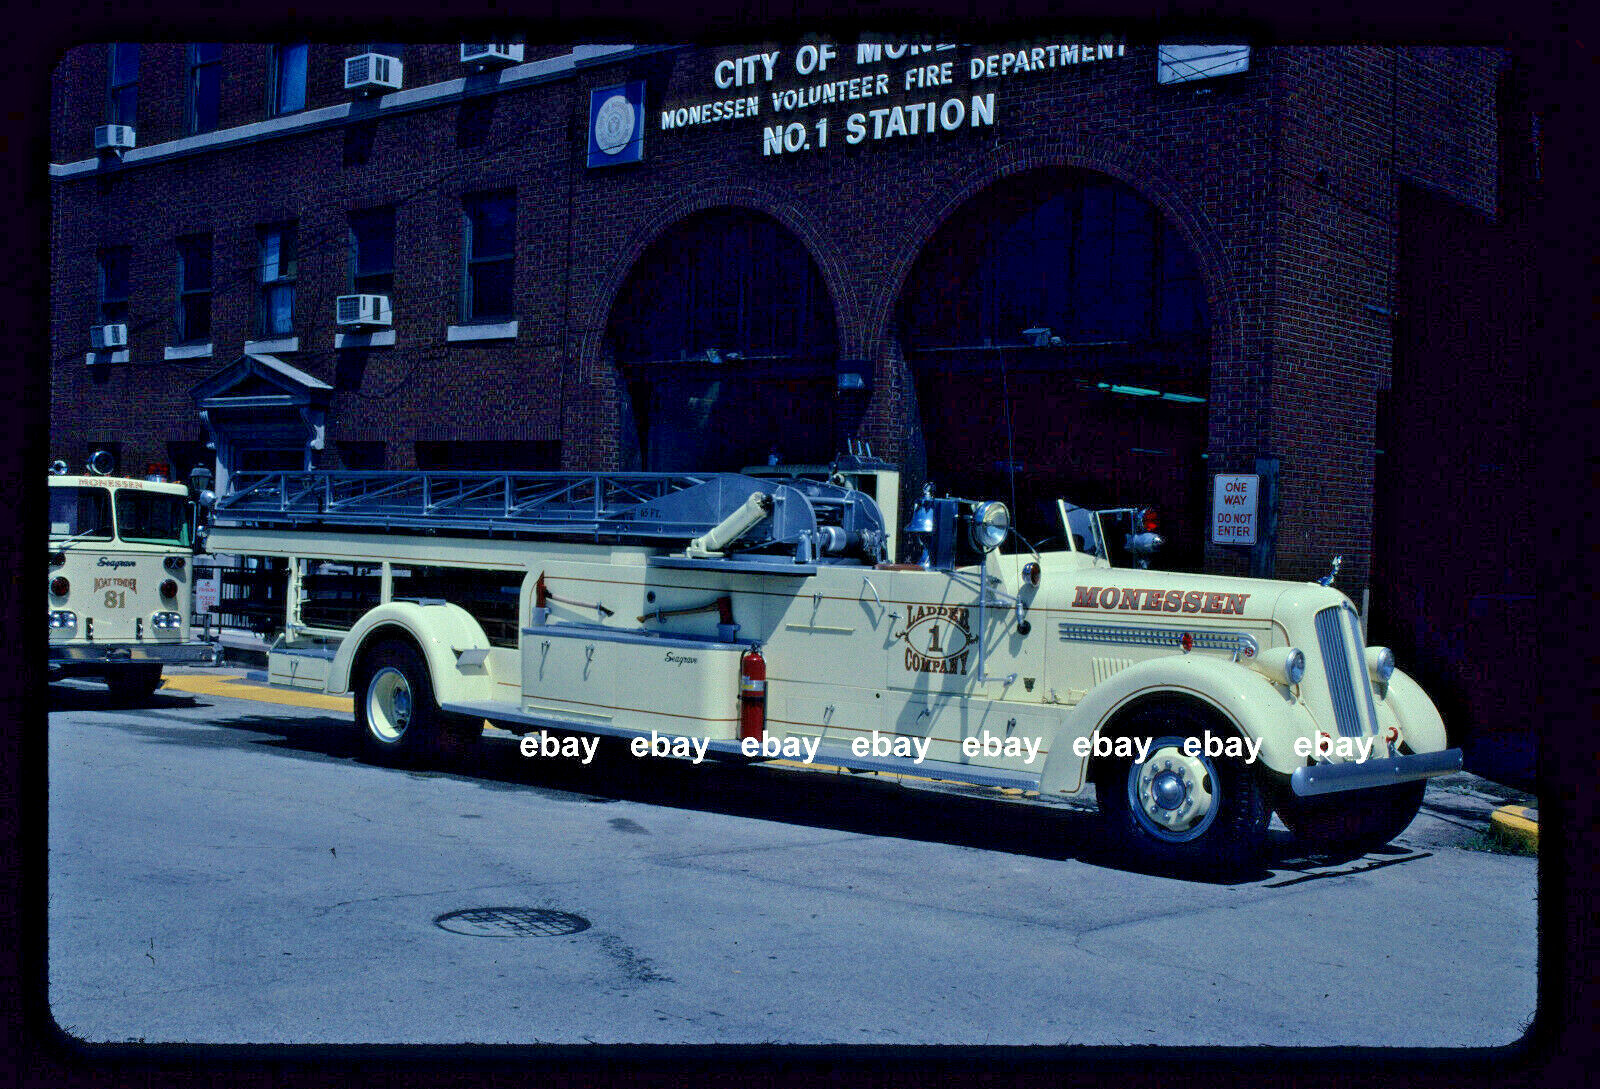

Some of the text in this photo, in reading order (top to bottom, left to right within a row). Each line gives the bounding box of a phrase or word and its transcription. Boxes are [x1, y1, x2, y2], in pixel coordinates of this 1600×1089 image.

[714, 51, 780, 89] CITY
[796, 44, 836, 75] OF
[661, 96, 759, 130] MONESSEN
[772, 74, 889, 112] VOLUNTEER
[905, 62, 953, 91] FIRE
[763, 93, 995, 156] NO.1 STATION
[78, 478, 144, 489] MONESSEN
[1225, 482, 1248, 493] ONE
[1224, 494, 1248, 505] WAY
[1217, 512, 1253, 524] DO NOT
[1217, 525, 1250, 537] ENTER
[97, 556, 136, 571] Seagrave
[104, 590, 126, 609] 81
[1071, 585, 1252, 616] MONESSEN
[906, 604, 971, 632] LADDER
[928, 625, 943, 652] 1
[664, 651, 698, 667] Seagrave
[904, 646, 969, 676] COMPANY
